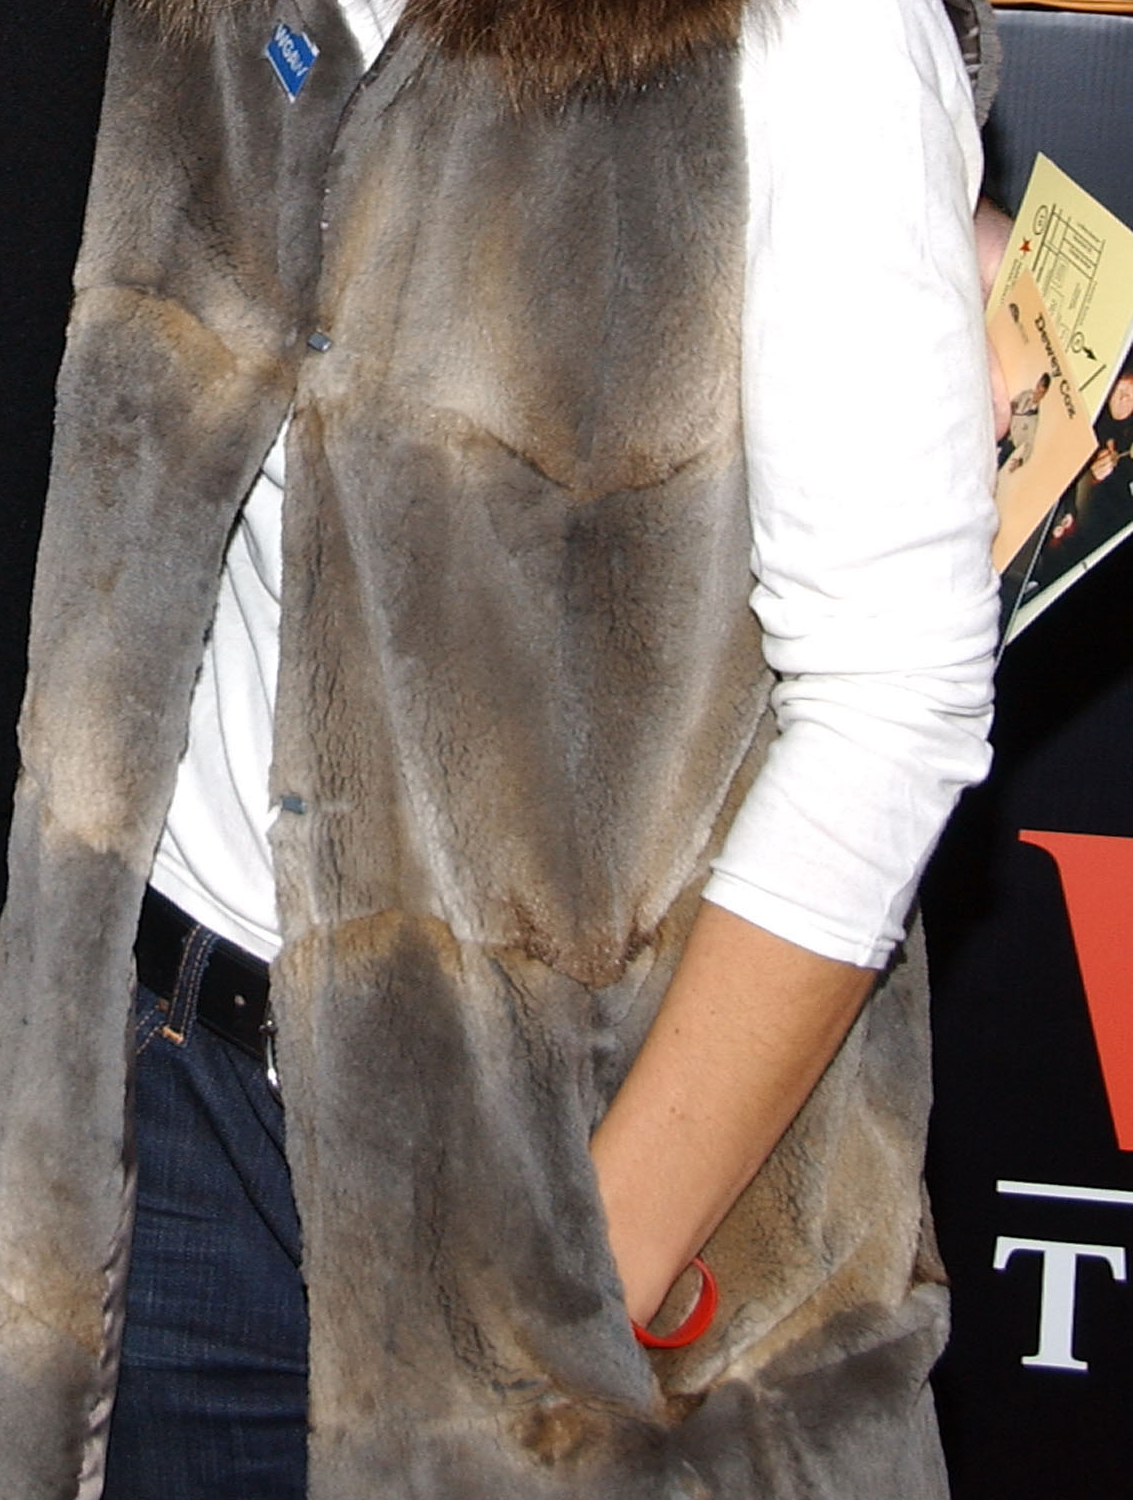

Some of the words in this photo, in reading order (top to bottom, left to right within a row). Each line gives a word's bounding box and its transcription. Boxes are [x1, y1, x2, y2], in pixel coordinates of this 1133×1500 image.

[1035, 313, 1062, 377] Dewey
[1060, 379, 1076, 419] Cox
[993, 1236, 1127, 1372] T
